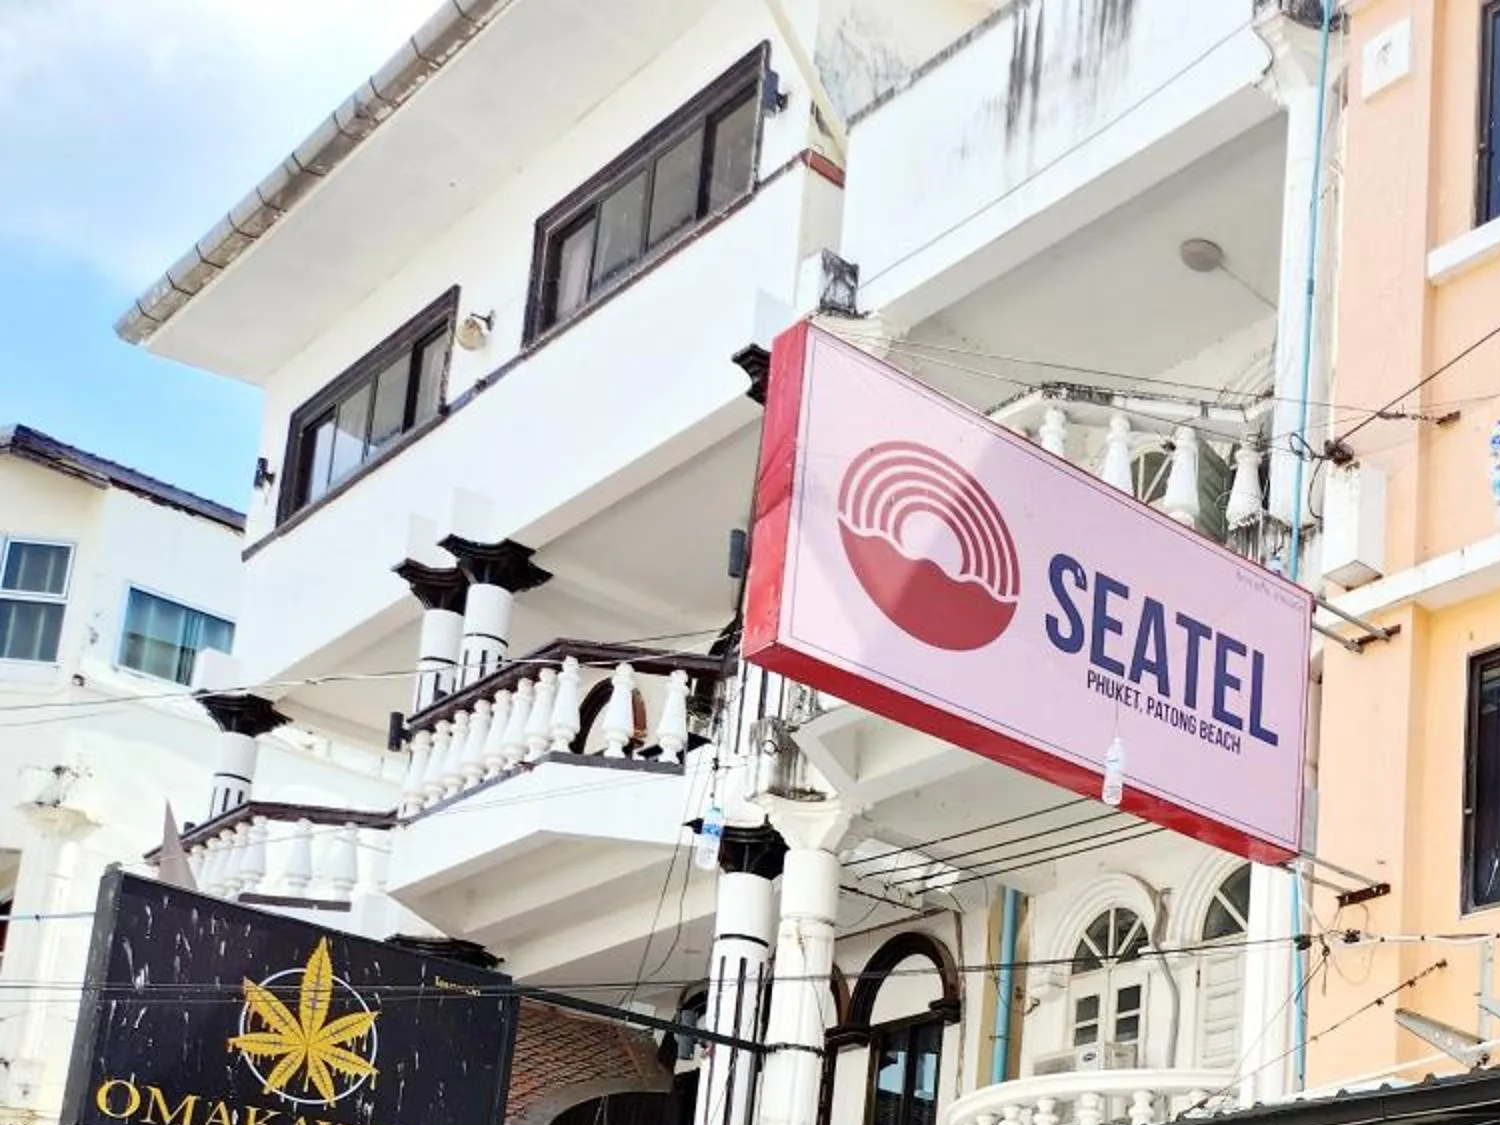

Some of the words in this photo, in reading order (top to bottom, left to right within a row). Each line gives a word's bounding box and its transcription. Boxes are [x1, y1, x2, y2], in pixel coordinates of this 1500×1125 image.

[1045, 553, 1279, 746] SEATEL
[1147, 696, 1197, 735] PATONG
[1200, 720, 1242, 754] BEACH
